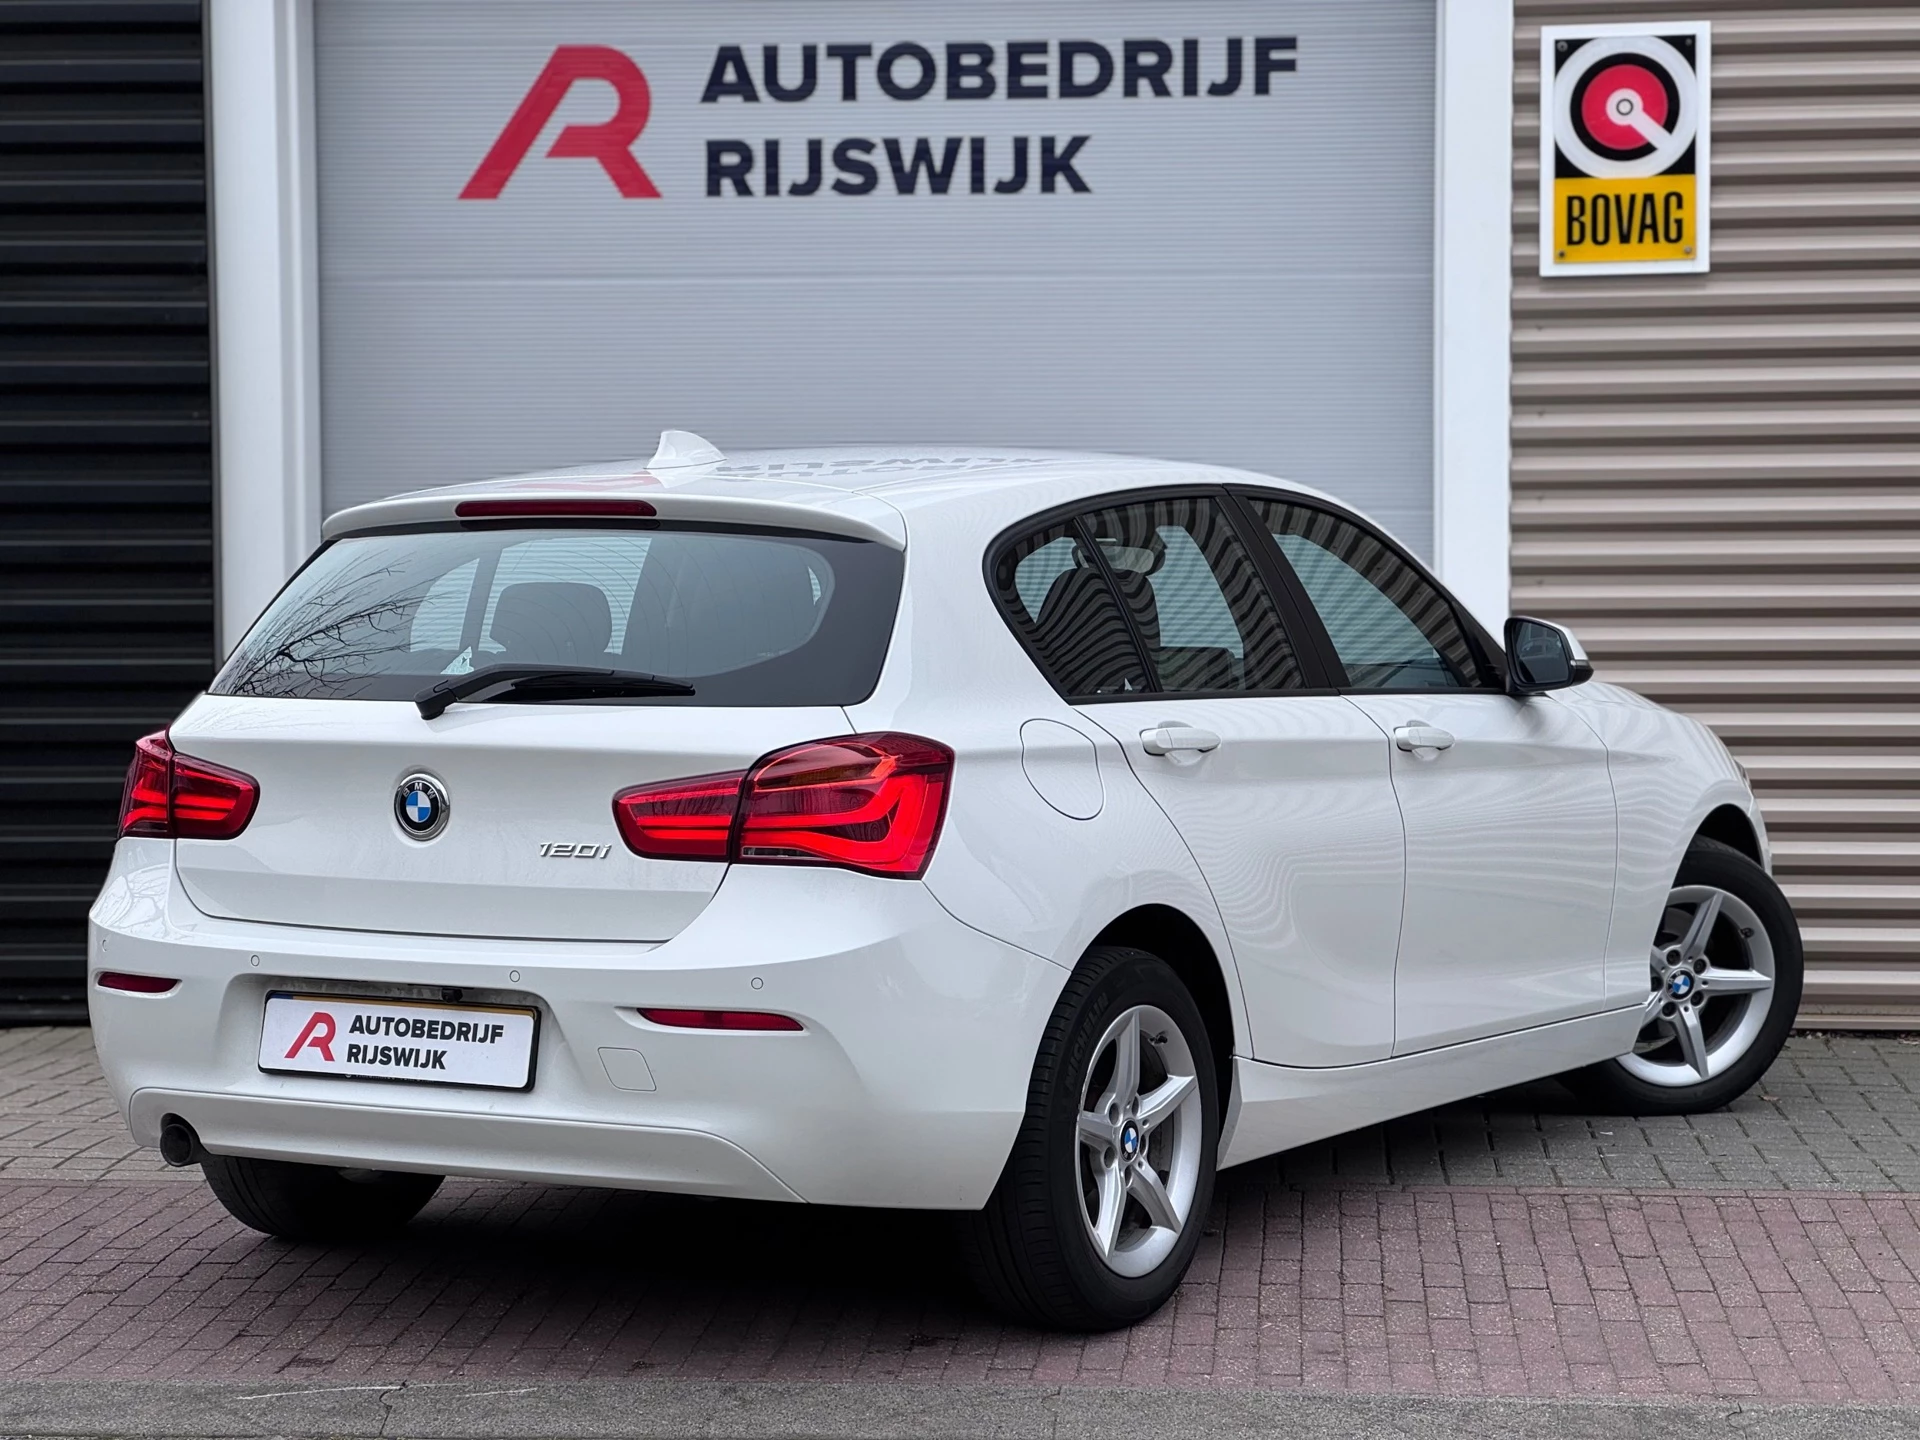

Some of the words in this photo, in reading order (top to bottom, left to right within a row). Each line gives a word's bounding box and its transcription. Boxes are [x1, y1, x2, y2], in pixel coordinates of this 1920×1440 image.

[700, 37, 1298, 103] AUTOBEDRIJF
[705, 135, 1092, 197] RIJSWIJK
[1566, 191, 1683, 246] BOVAG
[540, 842, 612, 859] 120i
[349, 1014, 504, 1044] AUTOBEDRIJF
[346, 1043, 448, 1070] RIJSWIJK
